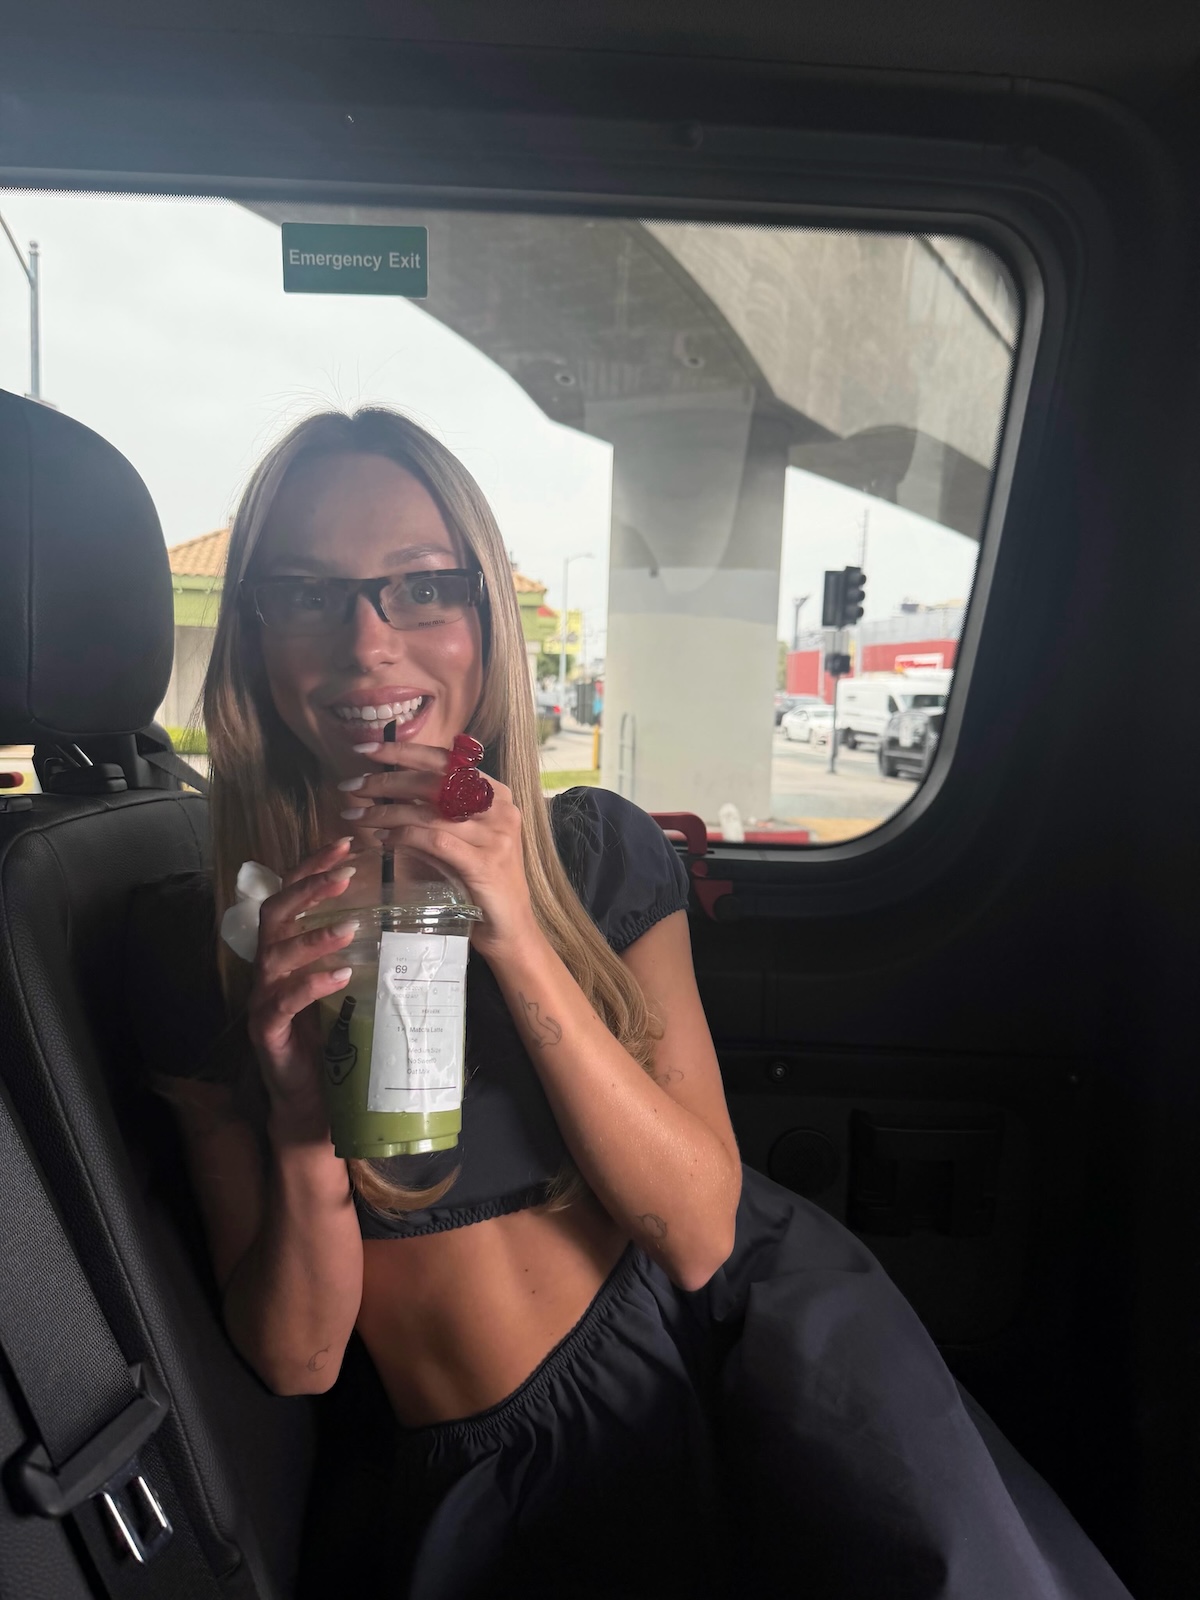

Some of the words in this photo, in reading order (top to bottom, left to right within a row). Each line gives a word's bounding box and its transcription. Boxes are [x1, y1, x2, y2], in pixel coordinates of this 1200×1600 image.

[289, 249, 382, 271] Emergency
[389, 252, 421, 269] Exit
[395, 964, 408, 974] 69
